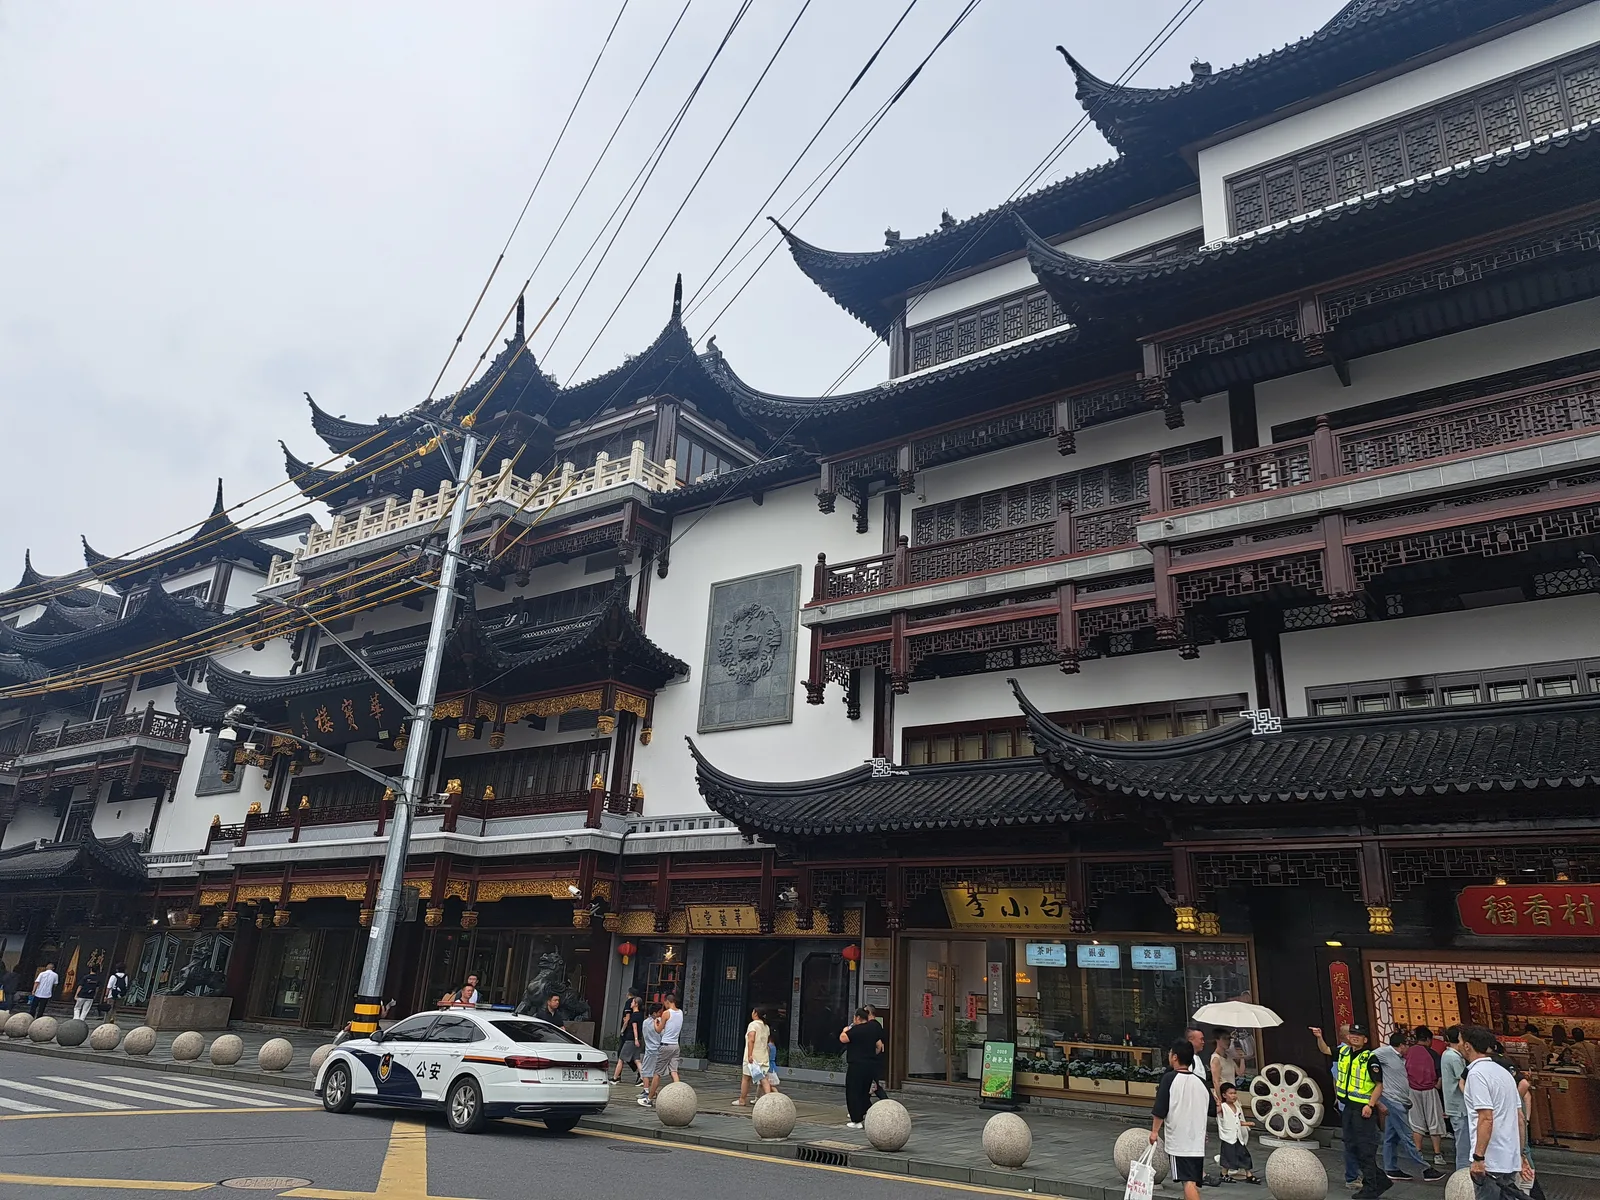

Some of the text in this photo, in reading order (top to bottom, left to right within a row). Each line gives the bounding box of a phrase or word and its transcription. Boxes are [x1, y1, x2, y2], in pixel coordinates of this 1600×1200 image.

[965, 891, 1063, 918] 李小白
[1482, 893, 1595, 926] 稻香村
[1037, 946, 1054, 956] 茶叶
[416, 1061, 442, 1081] 公安
